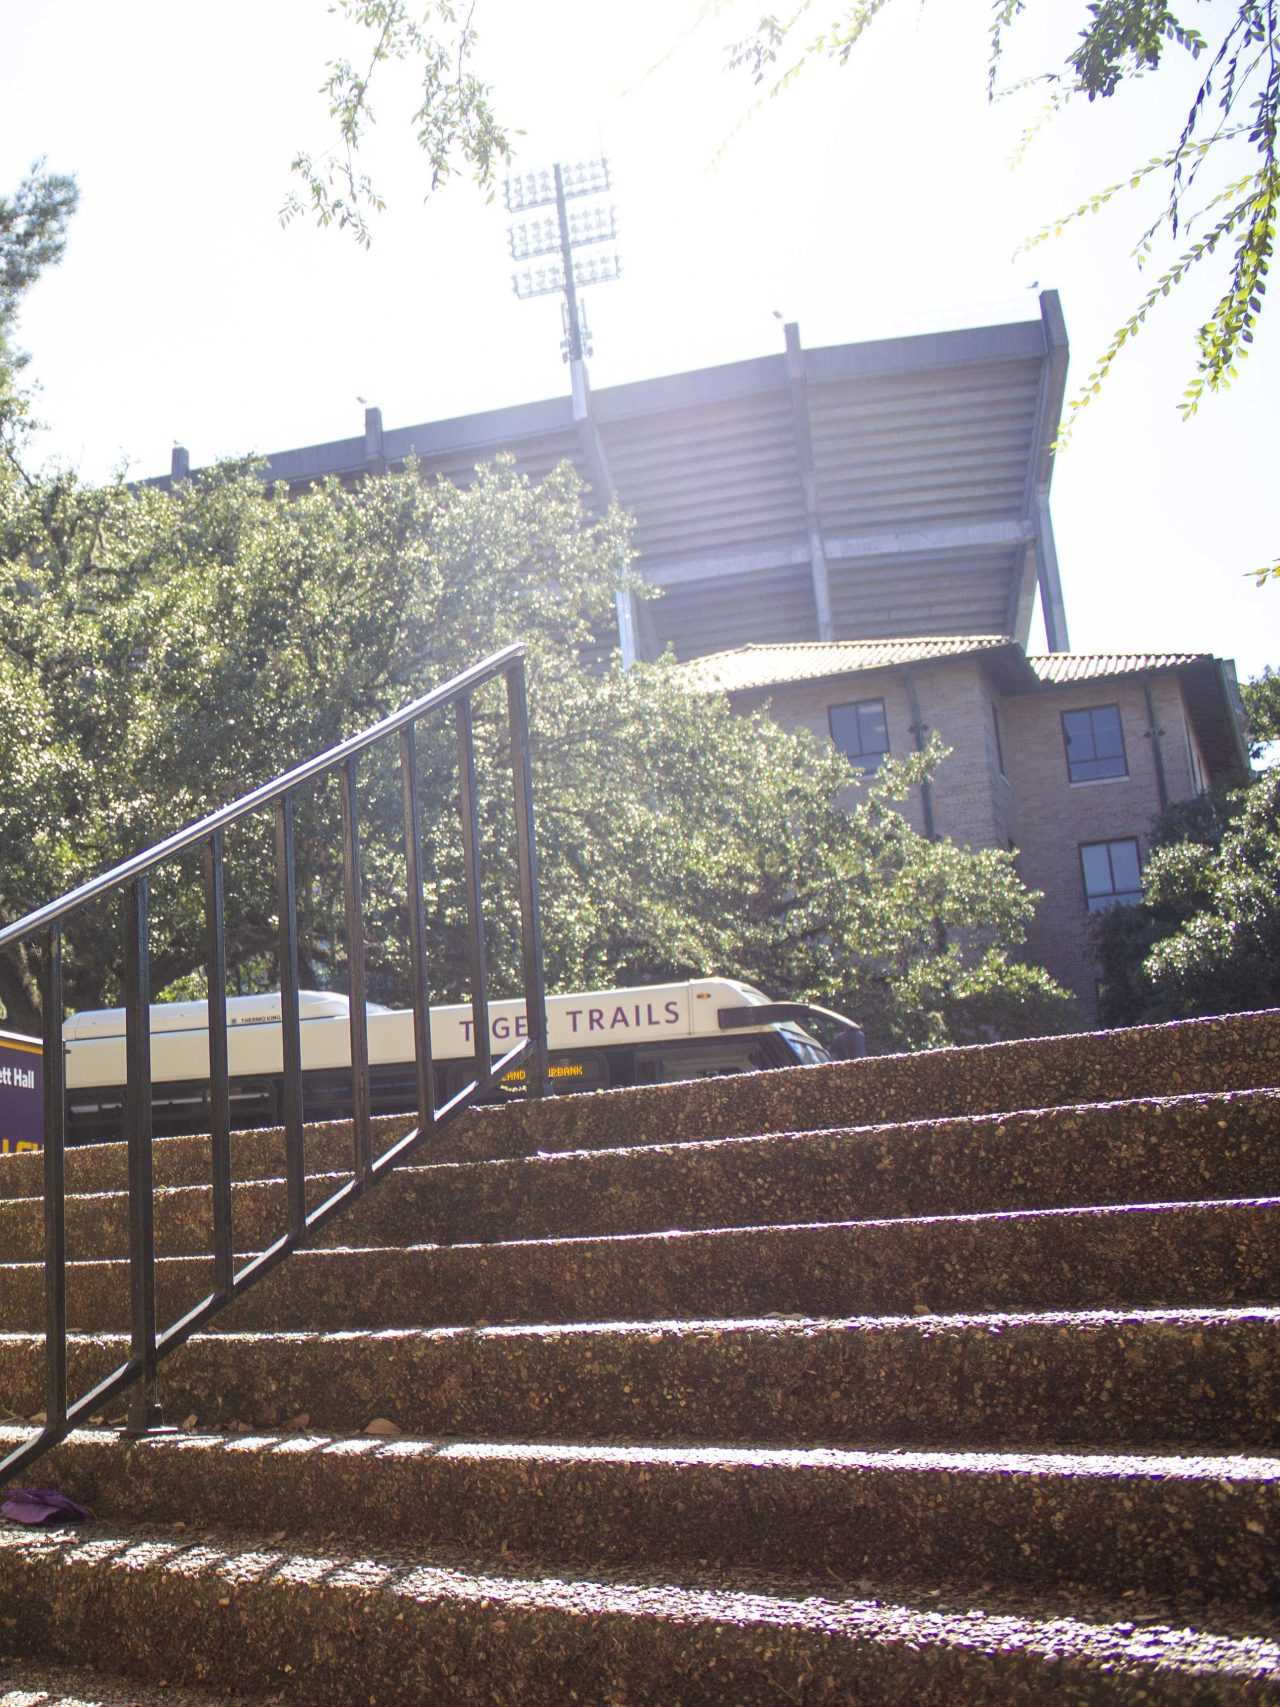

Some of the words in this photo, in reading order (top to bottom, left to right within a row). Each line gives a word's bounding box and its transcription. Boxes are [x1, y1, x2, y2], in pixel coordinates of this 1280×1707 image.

[458, 1015, 550, 1041] TGE
[566, 1001, 680, 1032] TRAILS
[13, 1068, 34, 1089] Hall
